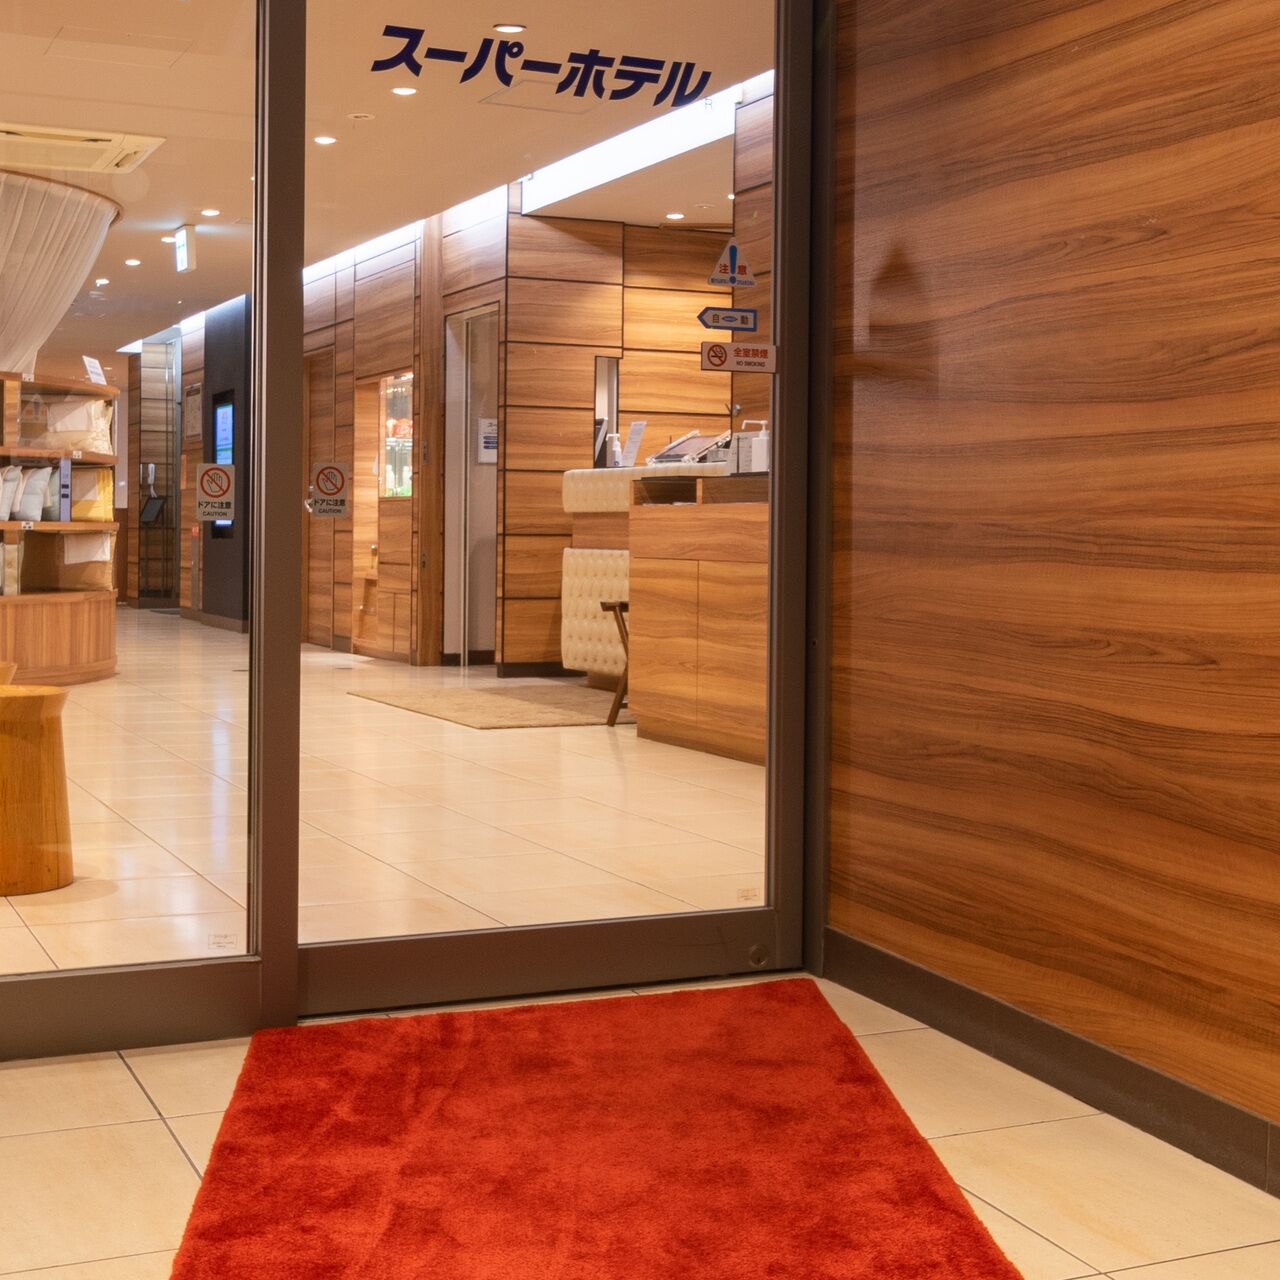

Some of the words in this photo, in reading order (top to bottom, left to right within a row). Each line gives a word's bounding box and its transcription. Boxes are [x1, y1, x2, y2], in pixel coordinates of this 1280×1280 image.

[371, 25, 711, 108] スーパーホテル
[733, 347, 768, 359] 全室禁煙
[199, 501, 231, 509] ドアに注意
